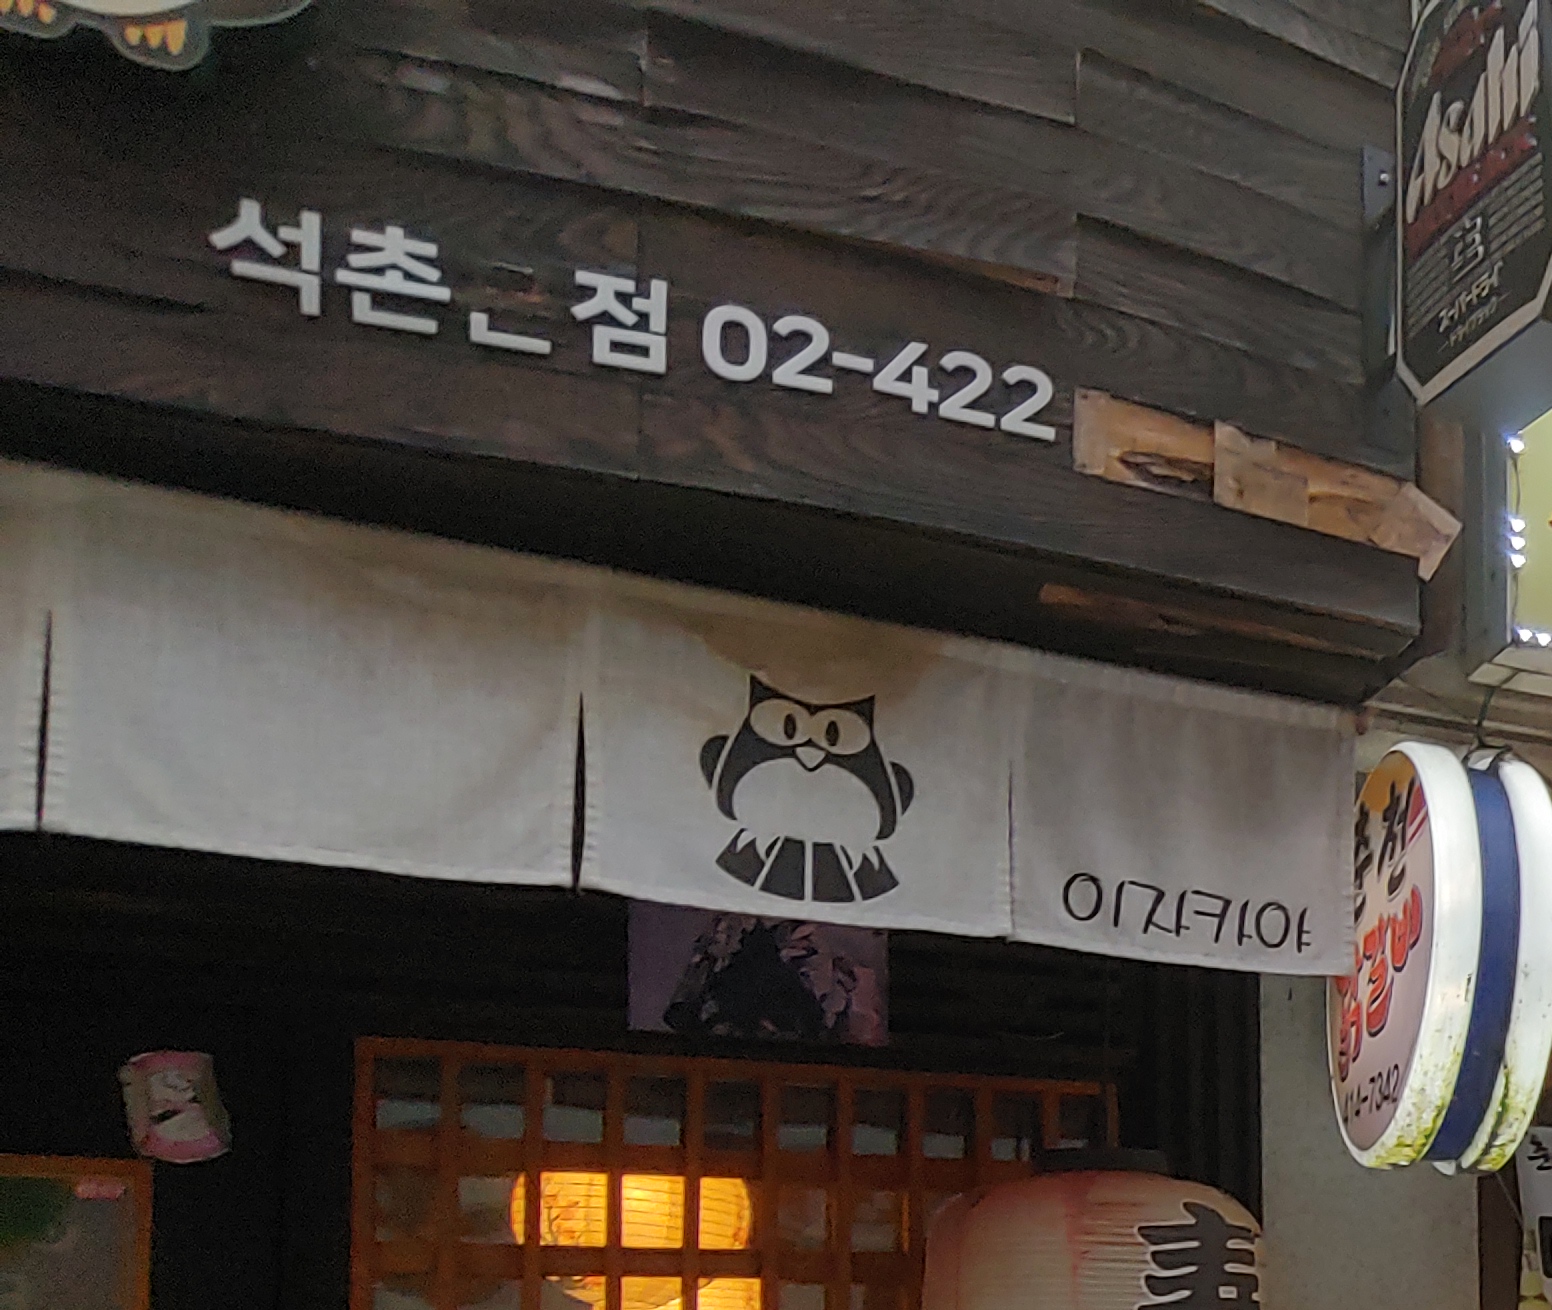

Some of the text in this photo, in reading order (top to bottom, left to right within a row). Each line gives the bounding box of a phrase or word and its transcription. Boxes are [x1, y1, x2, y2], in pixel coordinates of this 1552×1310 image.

[1406, 0, 1539, 225] Asahi
[702, 304, 1056, 442] 02-422
[1062, 872, 1311, 953] 이자카야
